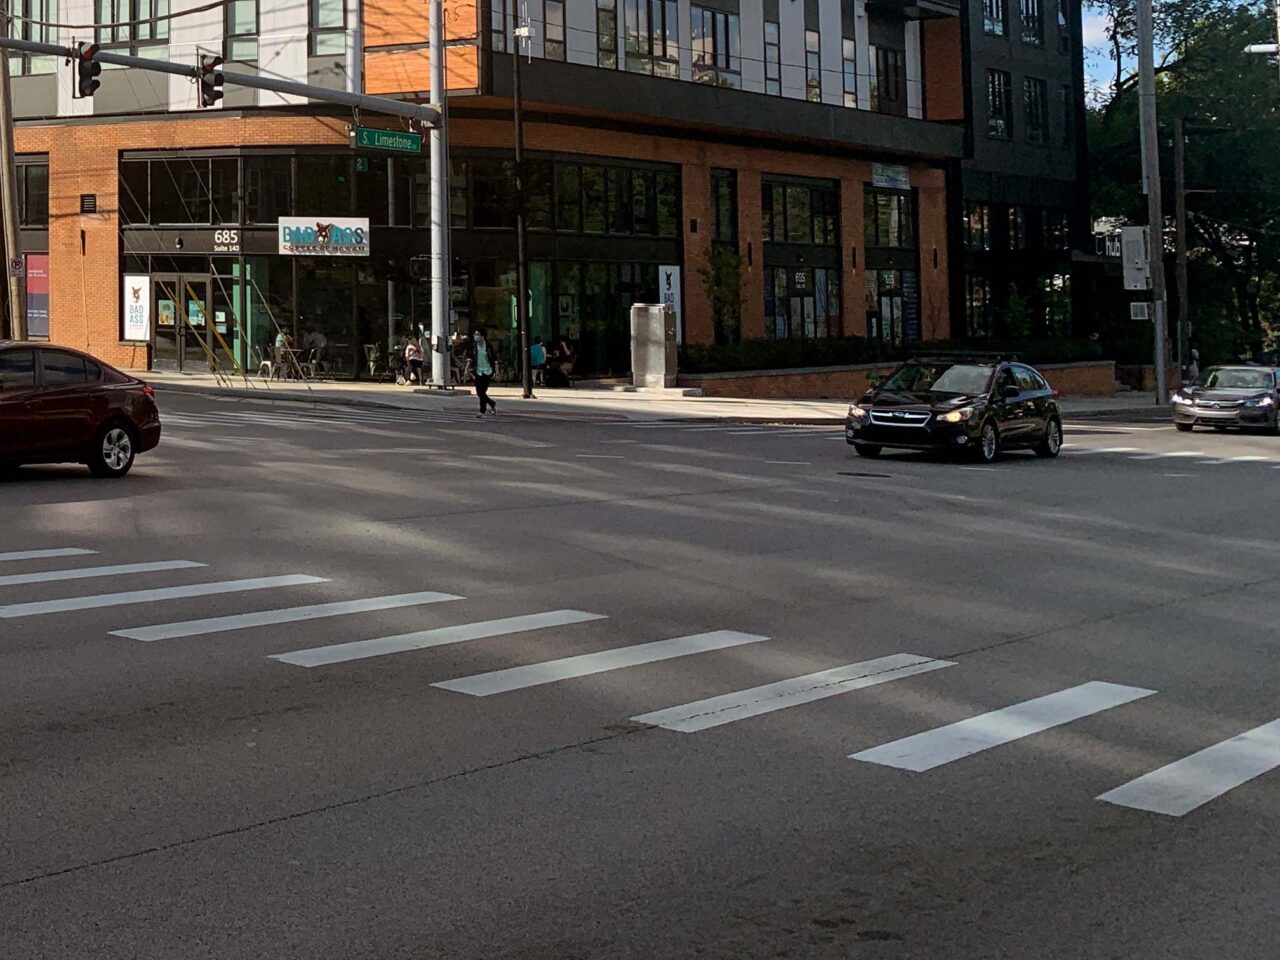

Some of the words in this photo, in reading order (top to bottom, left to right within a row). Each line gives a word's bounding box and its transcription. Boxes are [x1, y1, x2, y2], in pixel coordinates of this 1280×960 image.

[375, 132, 412, 149] Limestone
[214, 230, 238, 244] 685
[282, 226, 315, 244] BAD
[331, 224, 365, 245] ASS
[214, 244, 228, 252] Suite
[1105, 236, 1121, 257] hub
[128, 304, 144, 314] BAD
[128, 314, 144, 324] ASS
